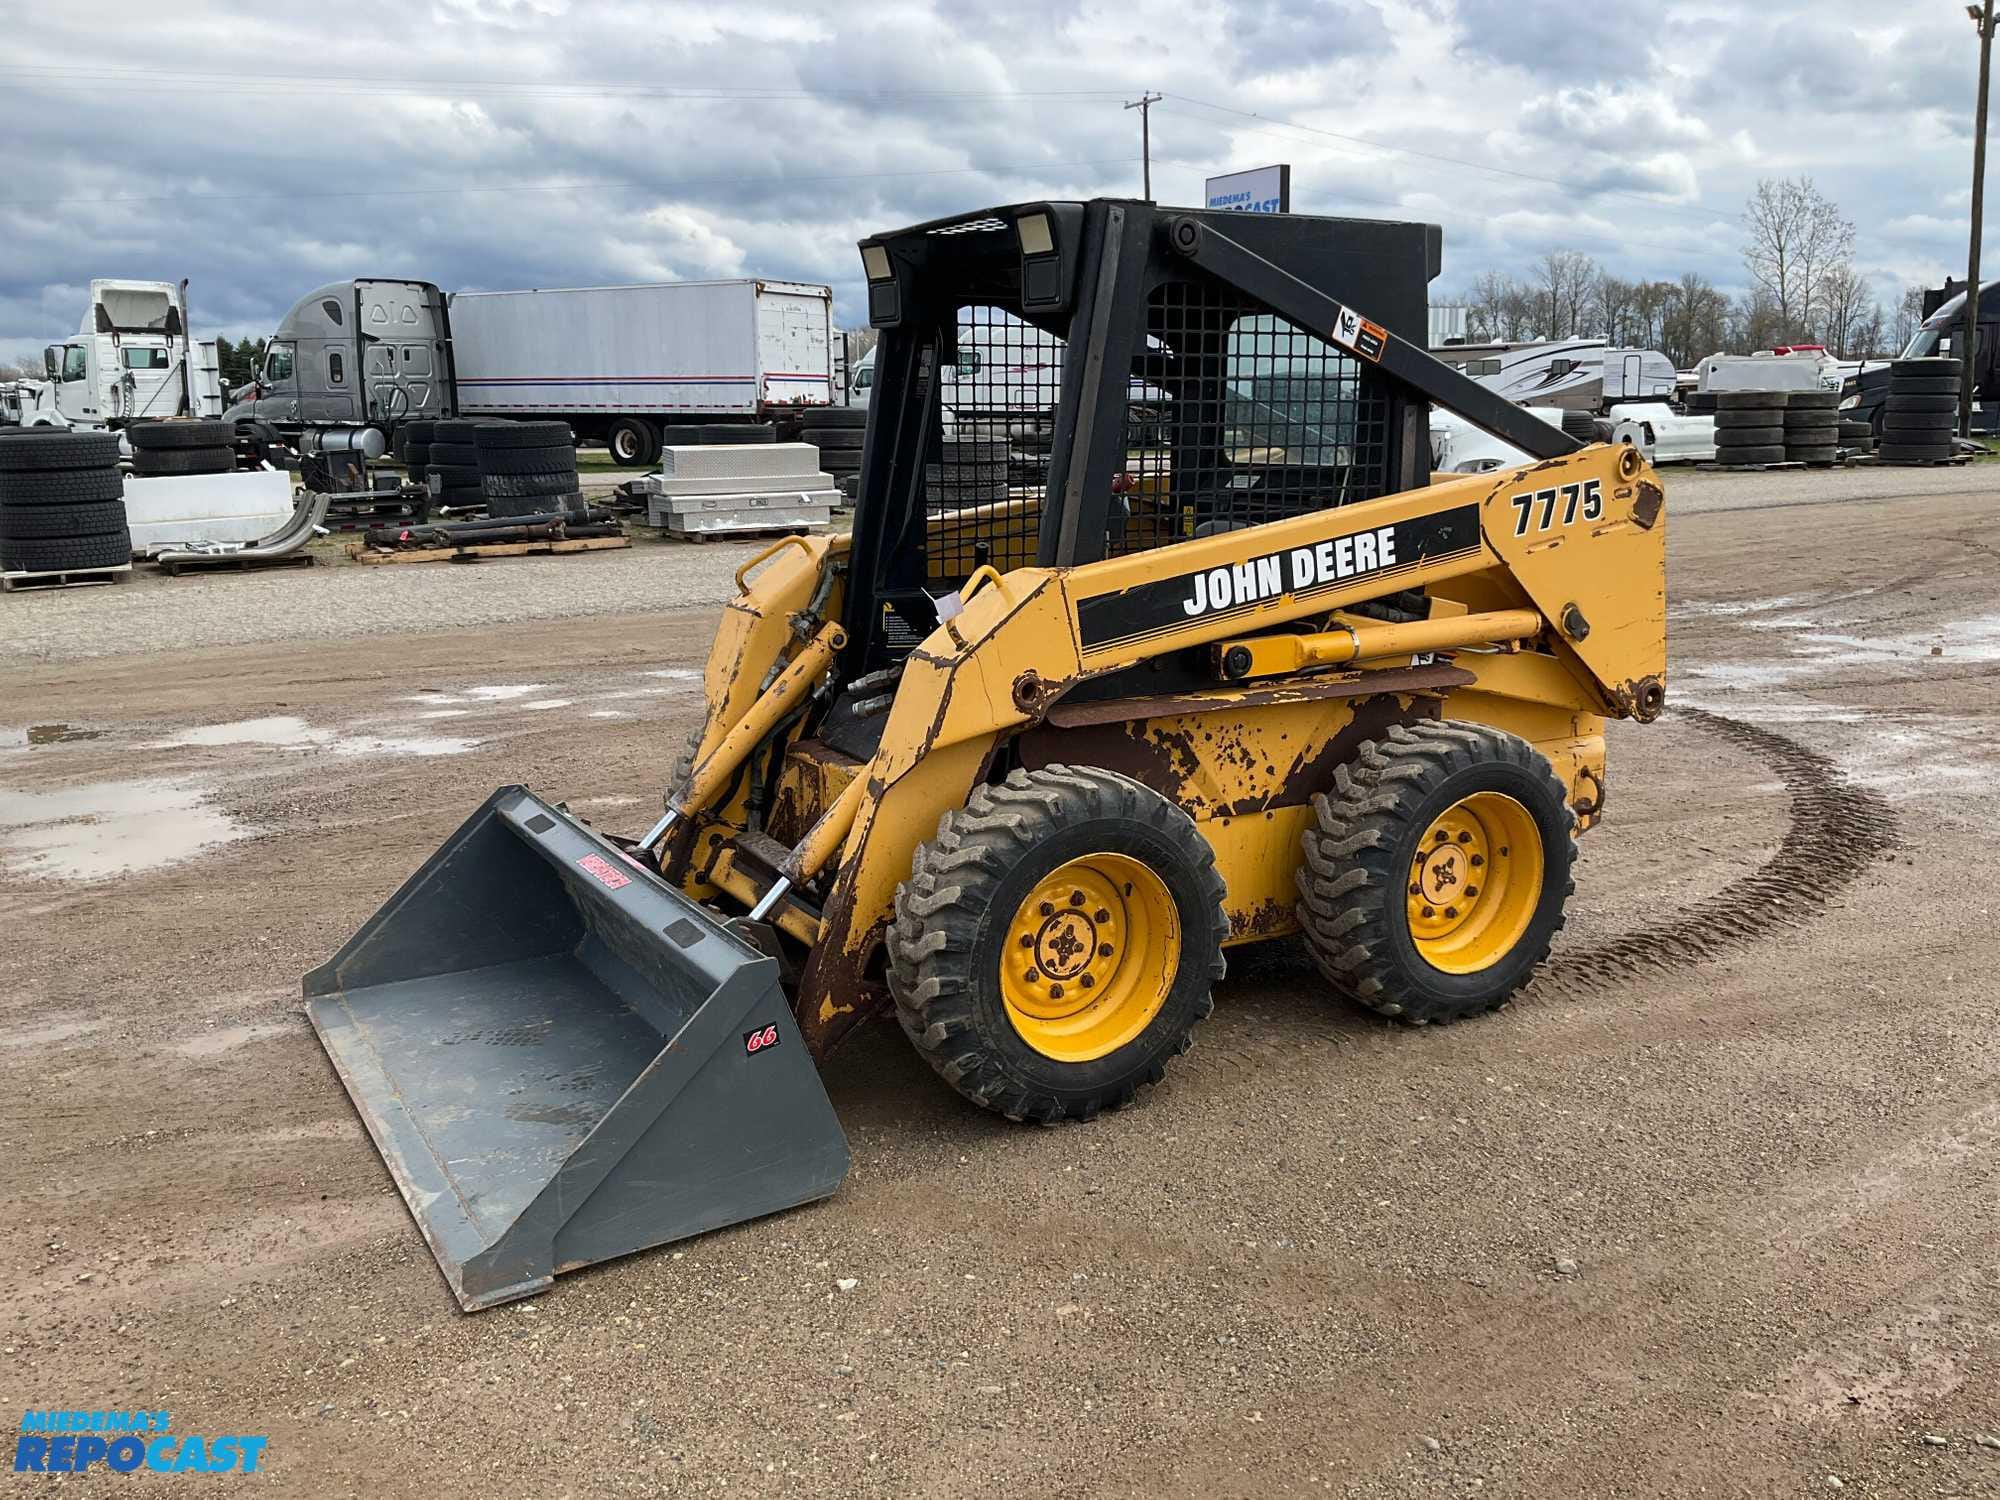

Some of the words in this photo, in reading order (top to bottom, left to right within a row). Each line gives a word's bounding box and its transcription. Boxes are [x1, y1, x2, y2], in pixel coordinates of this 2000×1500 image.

[1511, 478, 1602, 537] 7775
[1183, 555, 1282, 616] JOHN
[1291, 526, 1396, 589] DEERE
[747, 1025, 777, 1052] 66
